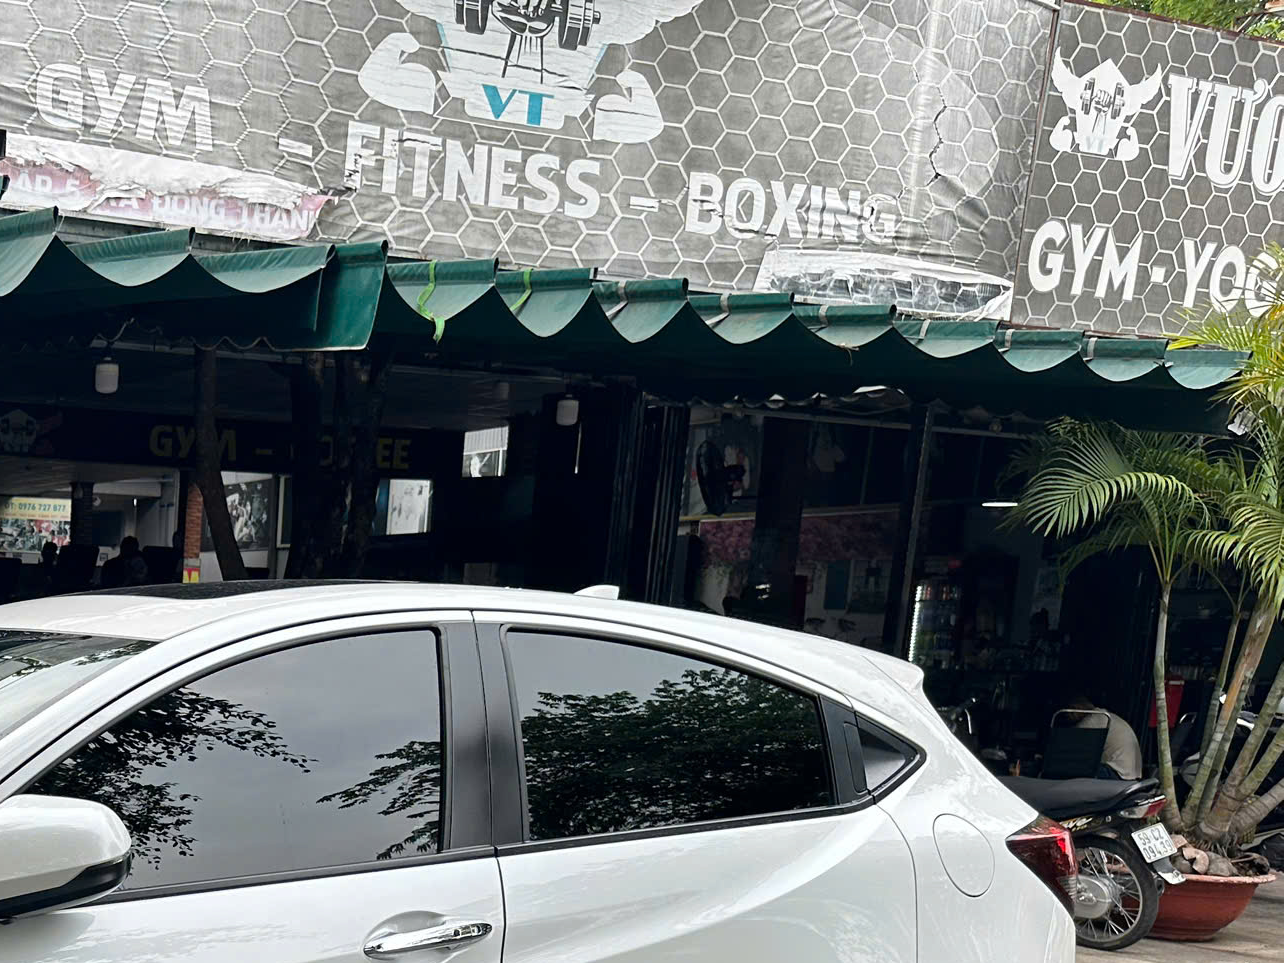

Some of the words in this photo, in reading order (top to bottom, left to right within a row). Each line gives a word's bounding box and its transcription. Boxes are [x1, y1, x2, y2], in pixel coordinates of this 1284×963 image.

[481, 83, 555, 126] VT
[35, 63, 213, 151] GYM
[343, 120, 601, 219] FITNESS
[685, 171, 903, 244] BOXING
[1028, 220, 1143, 302] GYM
